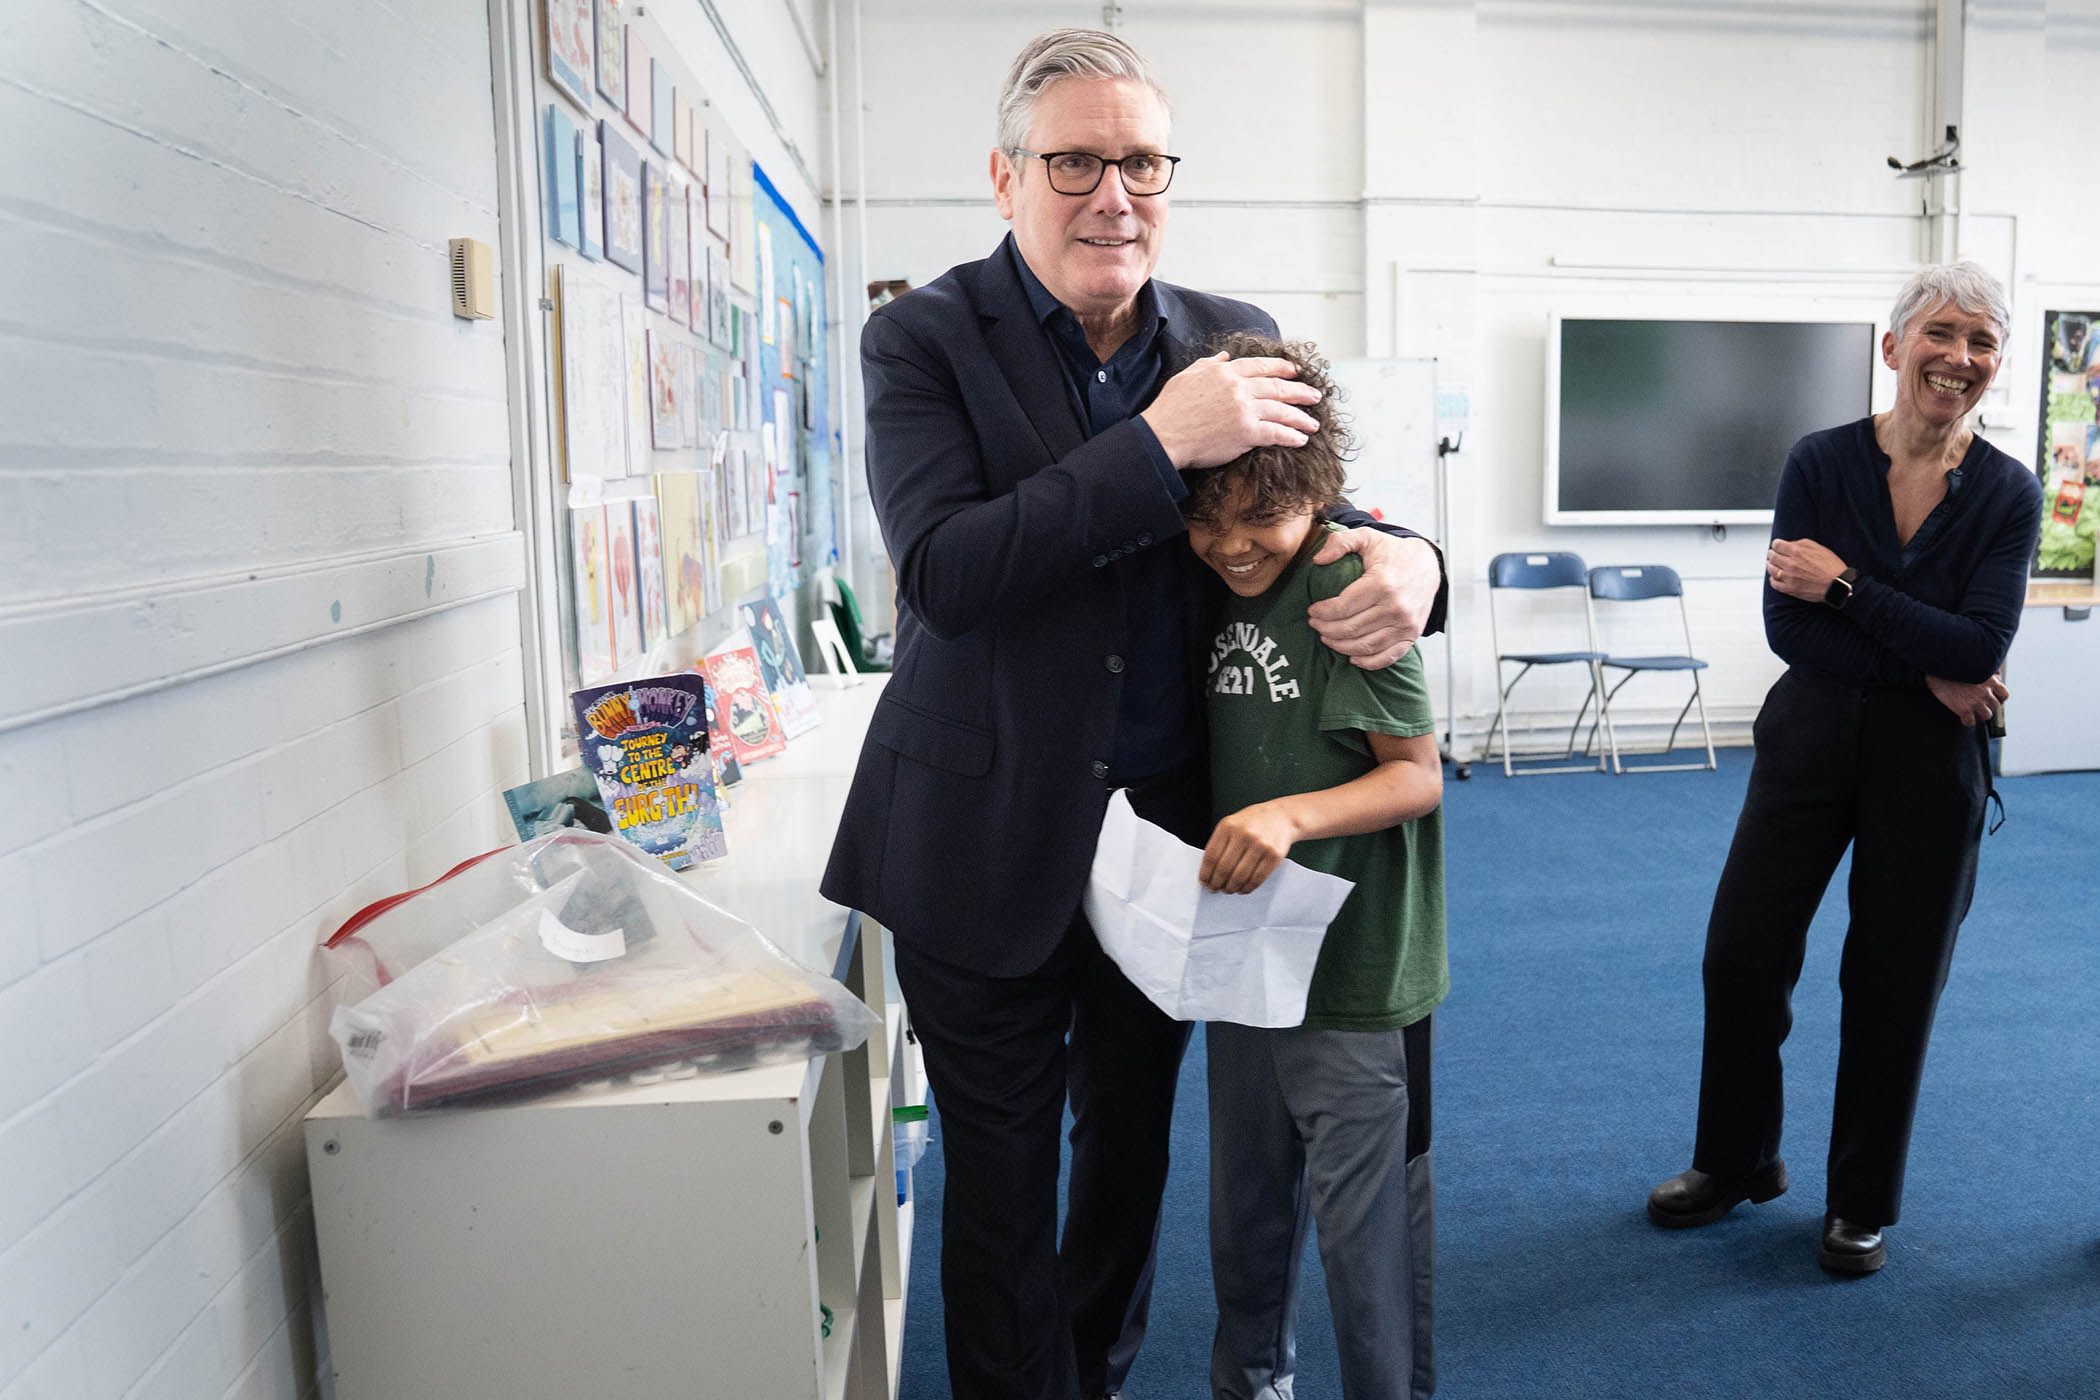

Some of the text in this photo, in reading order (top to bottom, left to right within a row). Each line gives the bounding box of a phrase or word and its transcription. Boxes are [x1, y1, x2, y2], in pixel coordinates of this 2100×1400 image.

[587, 692, 635, 736] BUNNY
[620, 732, 668, 752] JOURNEY
[627, 746, 663, 763] TO THE
[620, 757, 676, 784] CENTRE
[637, 778, 667, 792] OF THE
